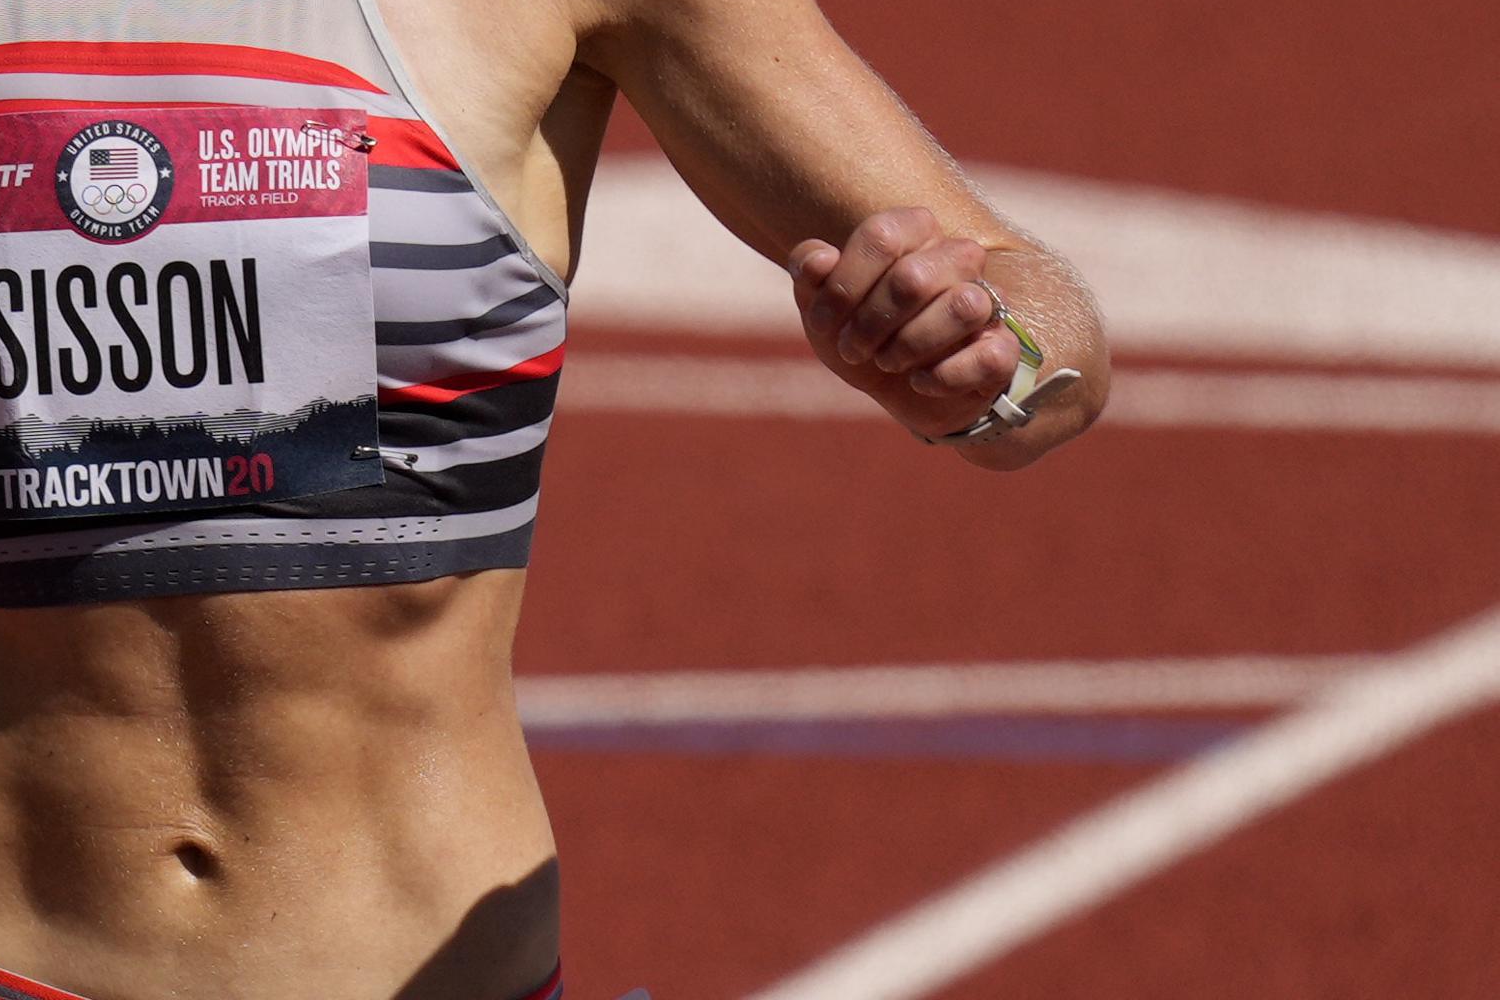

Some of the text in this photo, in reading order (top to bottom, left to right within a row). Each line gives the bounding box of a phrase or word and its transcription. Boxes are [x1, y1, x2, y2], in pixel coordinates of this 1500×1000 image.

[66, 123, 160, 155] UNITED STATES
[199, 127, 344, 161] U.S. OLYMPIC
[199, 159, 341, 193] TEAM TRIALS
[200, 192, 299, 208] TRACK & FIELD
[70, 206, 160, 237] OLYMPIC TEAM
